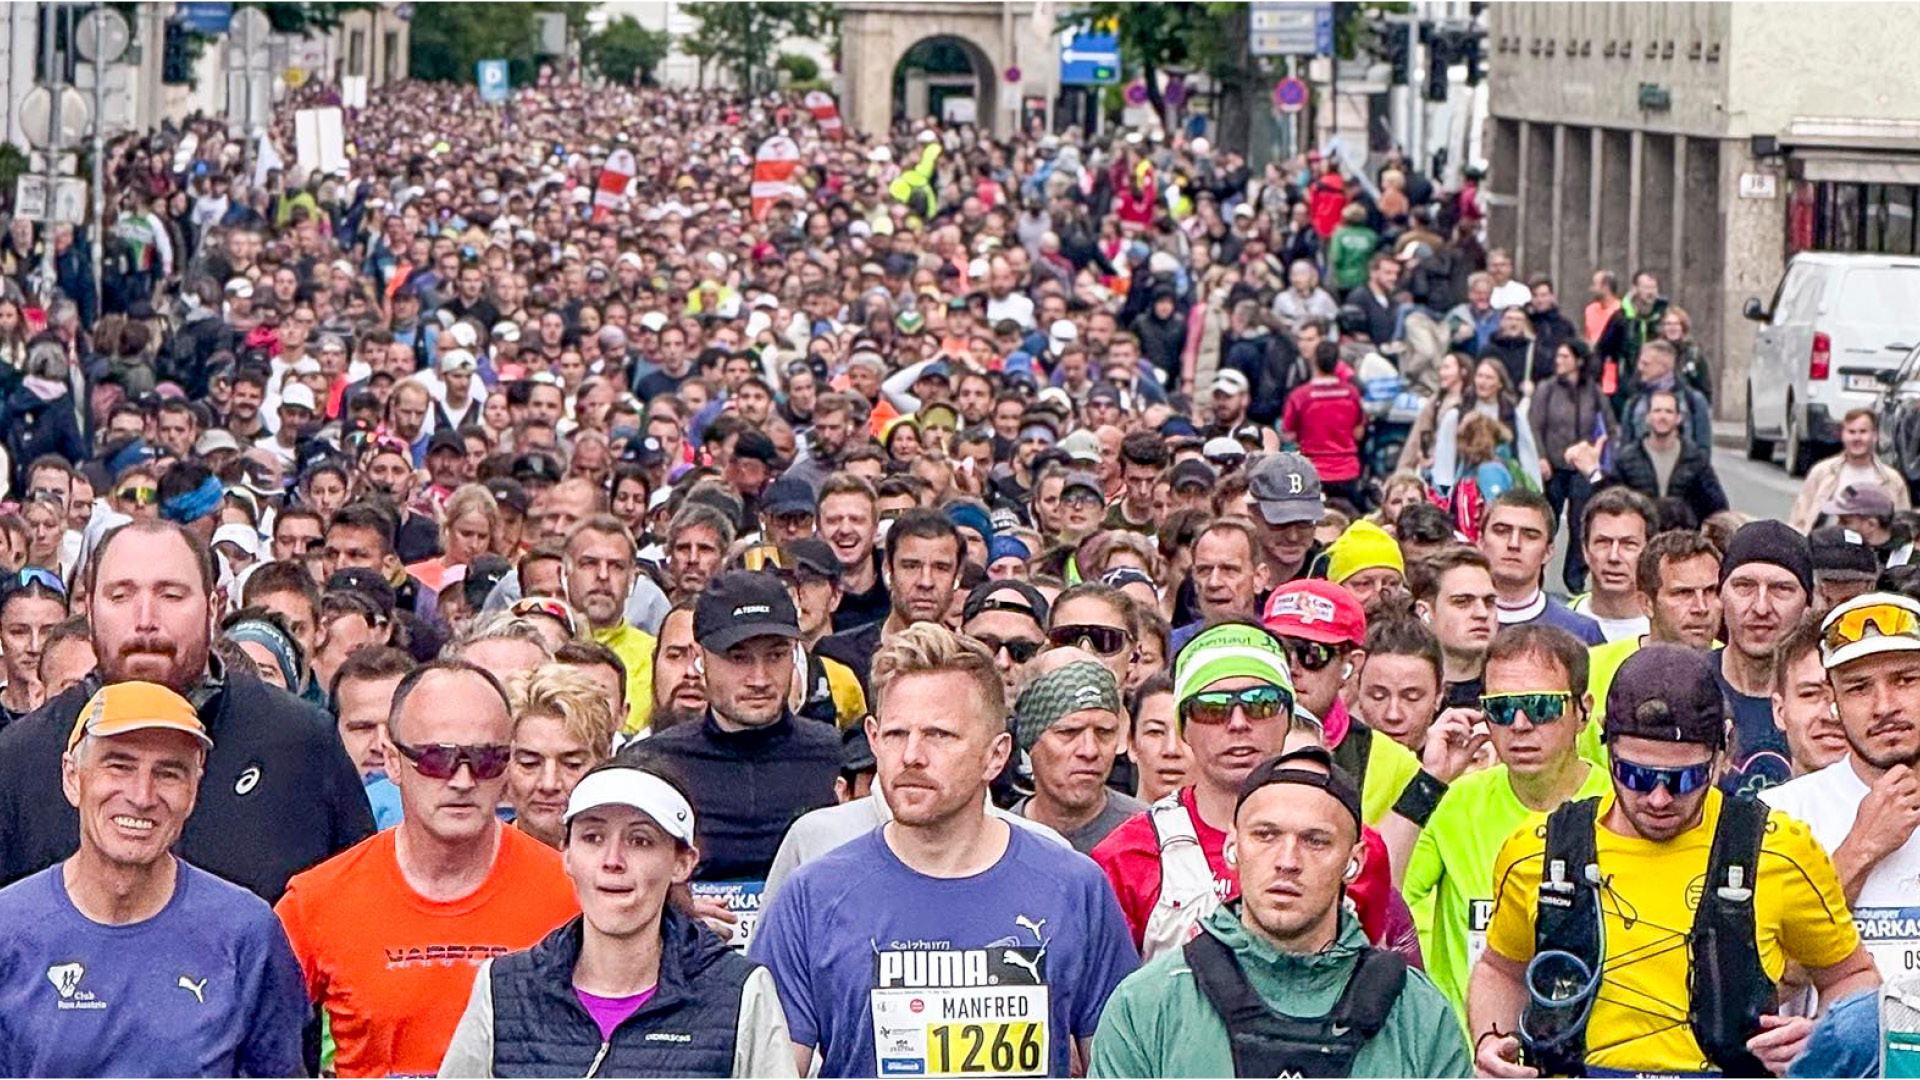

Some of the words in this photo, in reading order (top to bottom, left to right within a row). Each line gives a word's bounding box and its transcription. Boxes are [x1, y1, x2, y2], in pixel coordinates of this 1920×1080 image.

[1287, 474, 1303, 493] B
[942, 995, 1028, 1019] MANFRED
[932, 1023, 1041, 1073] 1266
